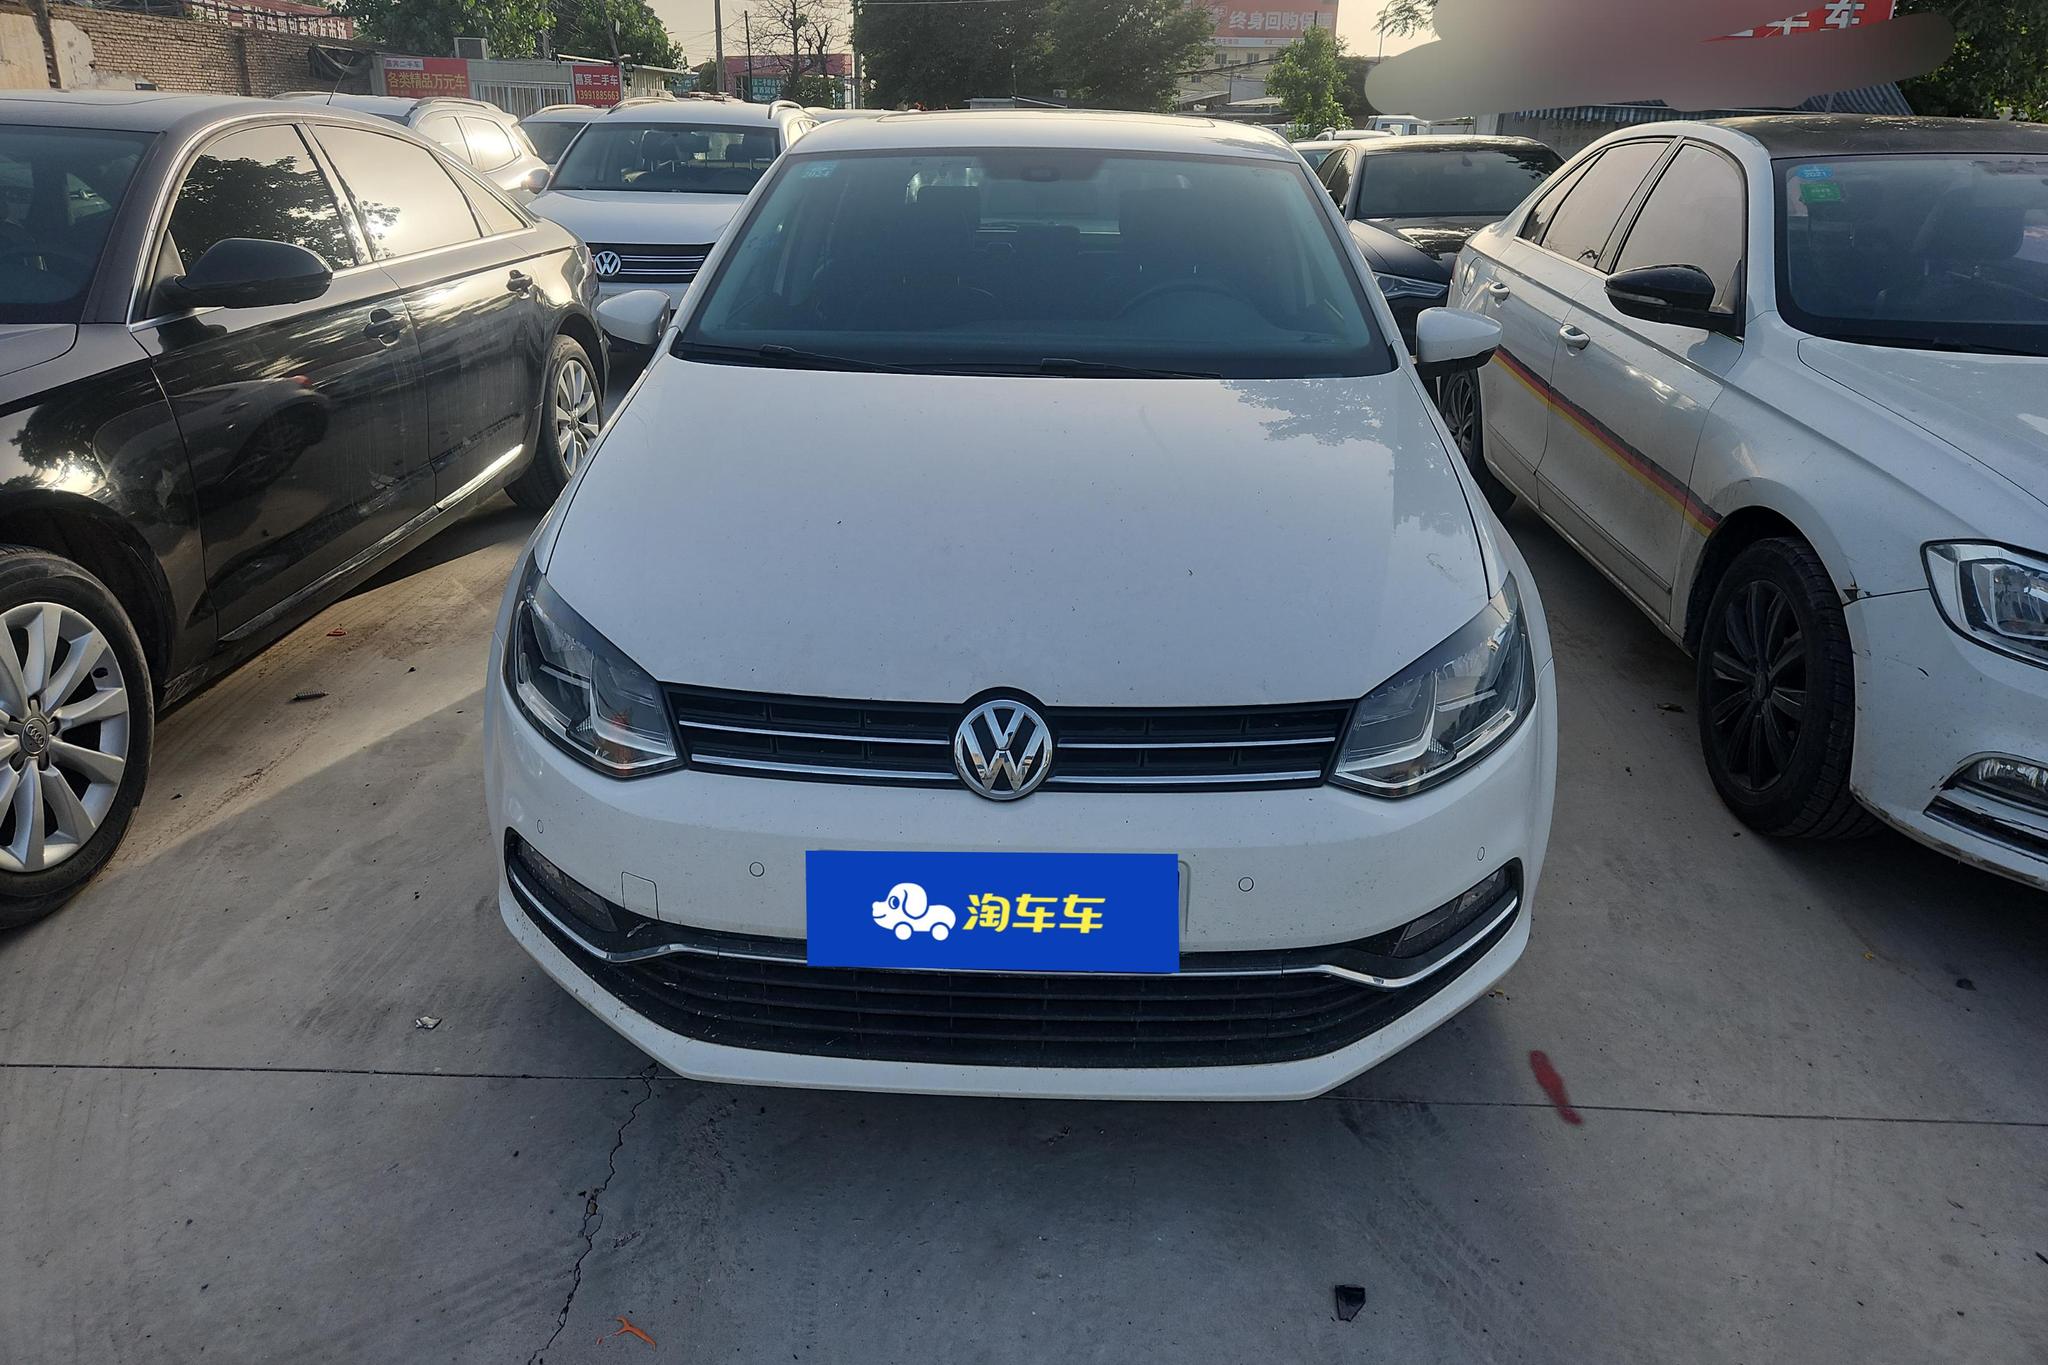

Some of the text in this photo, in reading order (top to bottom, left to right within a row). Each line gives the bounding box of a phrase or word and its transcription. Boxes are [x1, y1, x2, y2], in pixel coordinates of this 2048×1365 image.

[388, 72, 467, 89] 各类精品万元车
[959, 702, 1046, 797] VW
